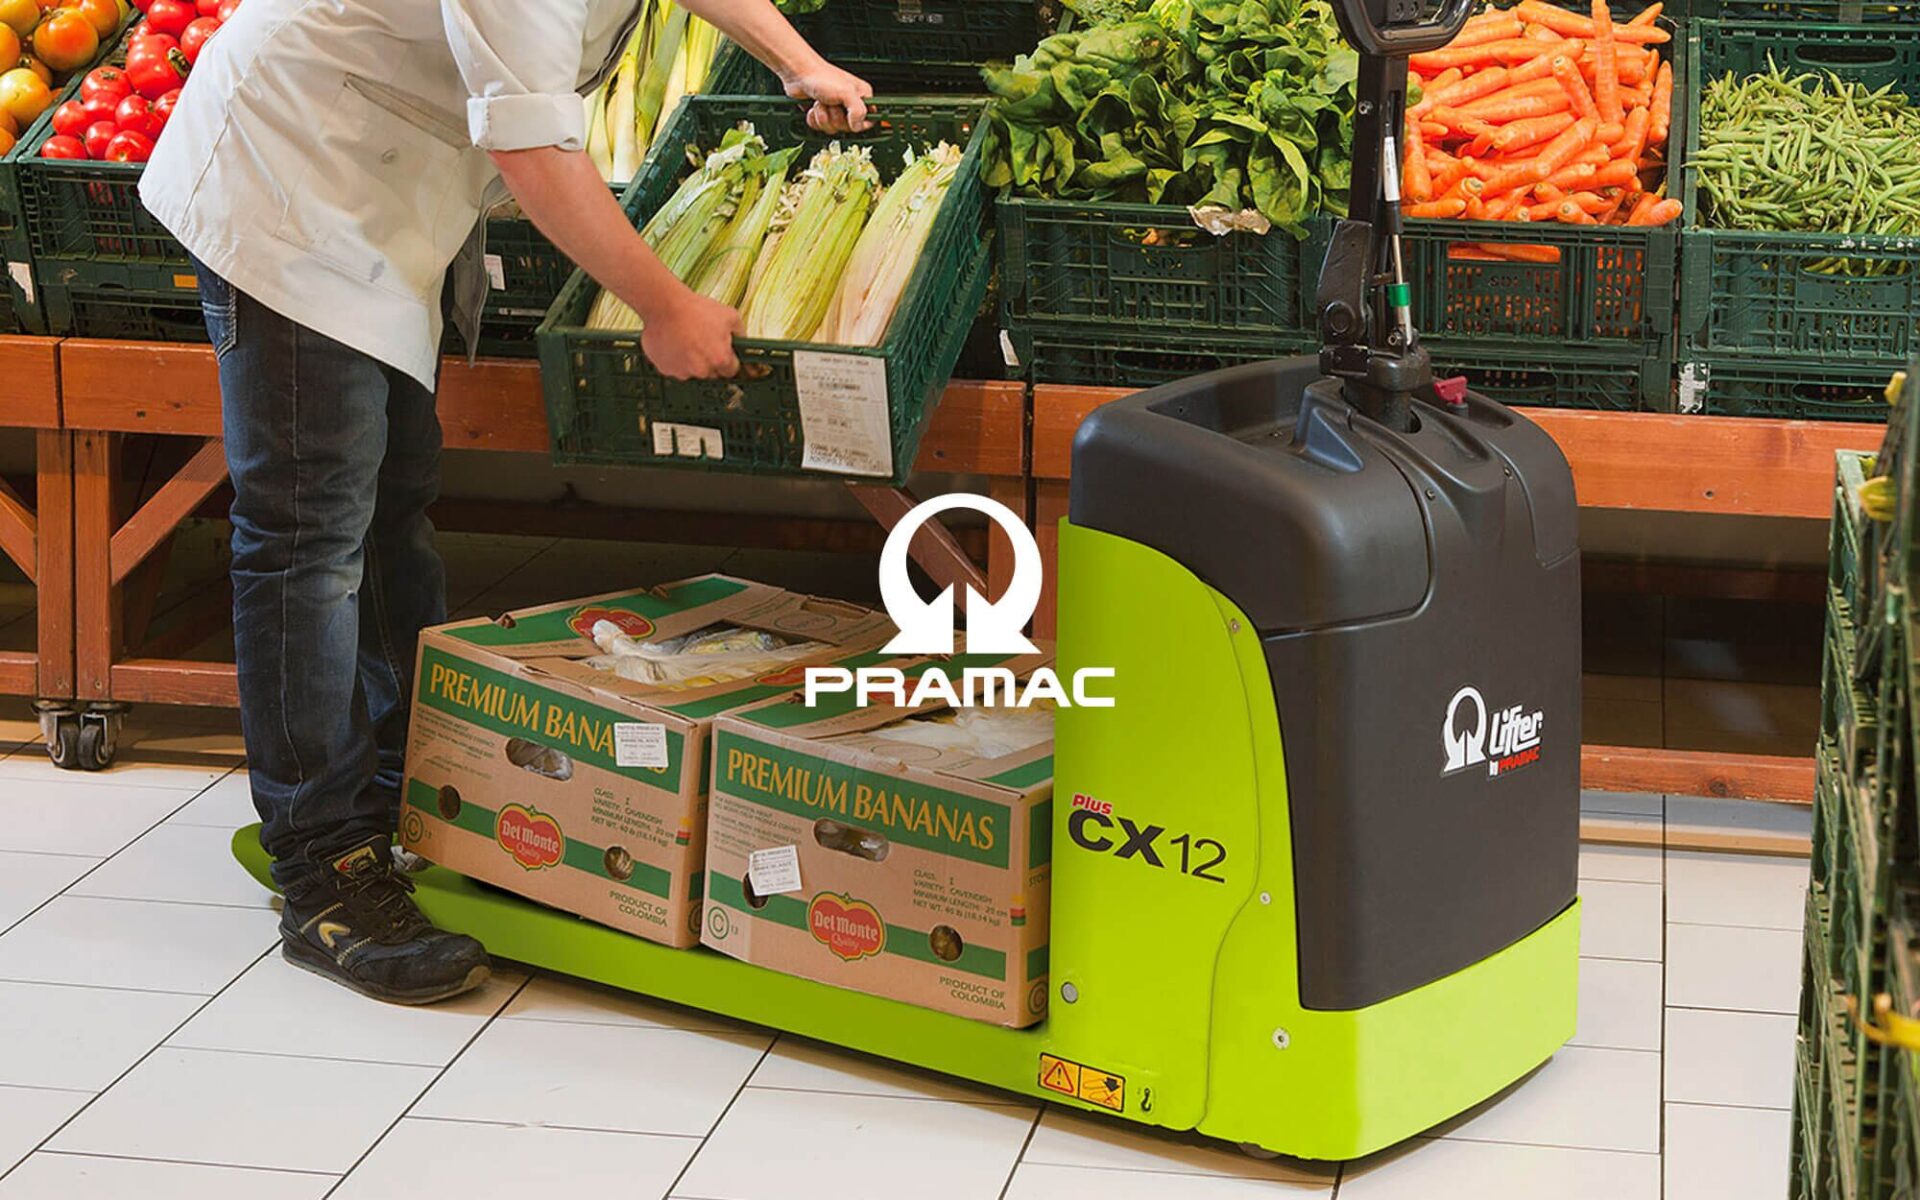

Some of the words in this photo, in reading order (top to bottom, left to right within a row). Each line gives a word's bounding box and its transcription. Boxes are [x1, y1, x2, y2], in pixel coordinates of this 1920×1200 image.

[430, 663, 541, 732] PREMIUM
[1489, 704, 1544, 756] Lifter
[727, 748, 848, 816] PREMIUM
[852, 784, 995, 850] BANANAS
[502, 820, 521, 840] Del
[522, 827, 560, 854] Monte
[610, 890, 653, 911] PRODUCT
[655, 906, 668, 917] OF
[619, 904, 668, 927] COLOMBIA
[815, 910, 836, 932] Del
[836, 916, 879, 942] Monte
[939, 976, 988, 995] PRODUCT
[991, 988, 1006, 999] OF
[950, 989, 1007, 1010] COLOMBIA
